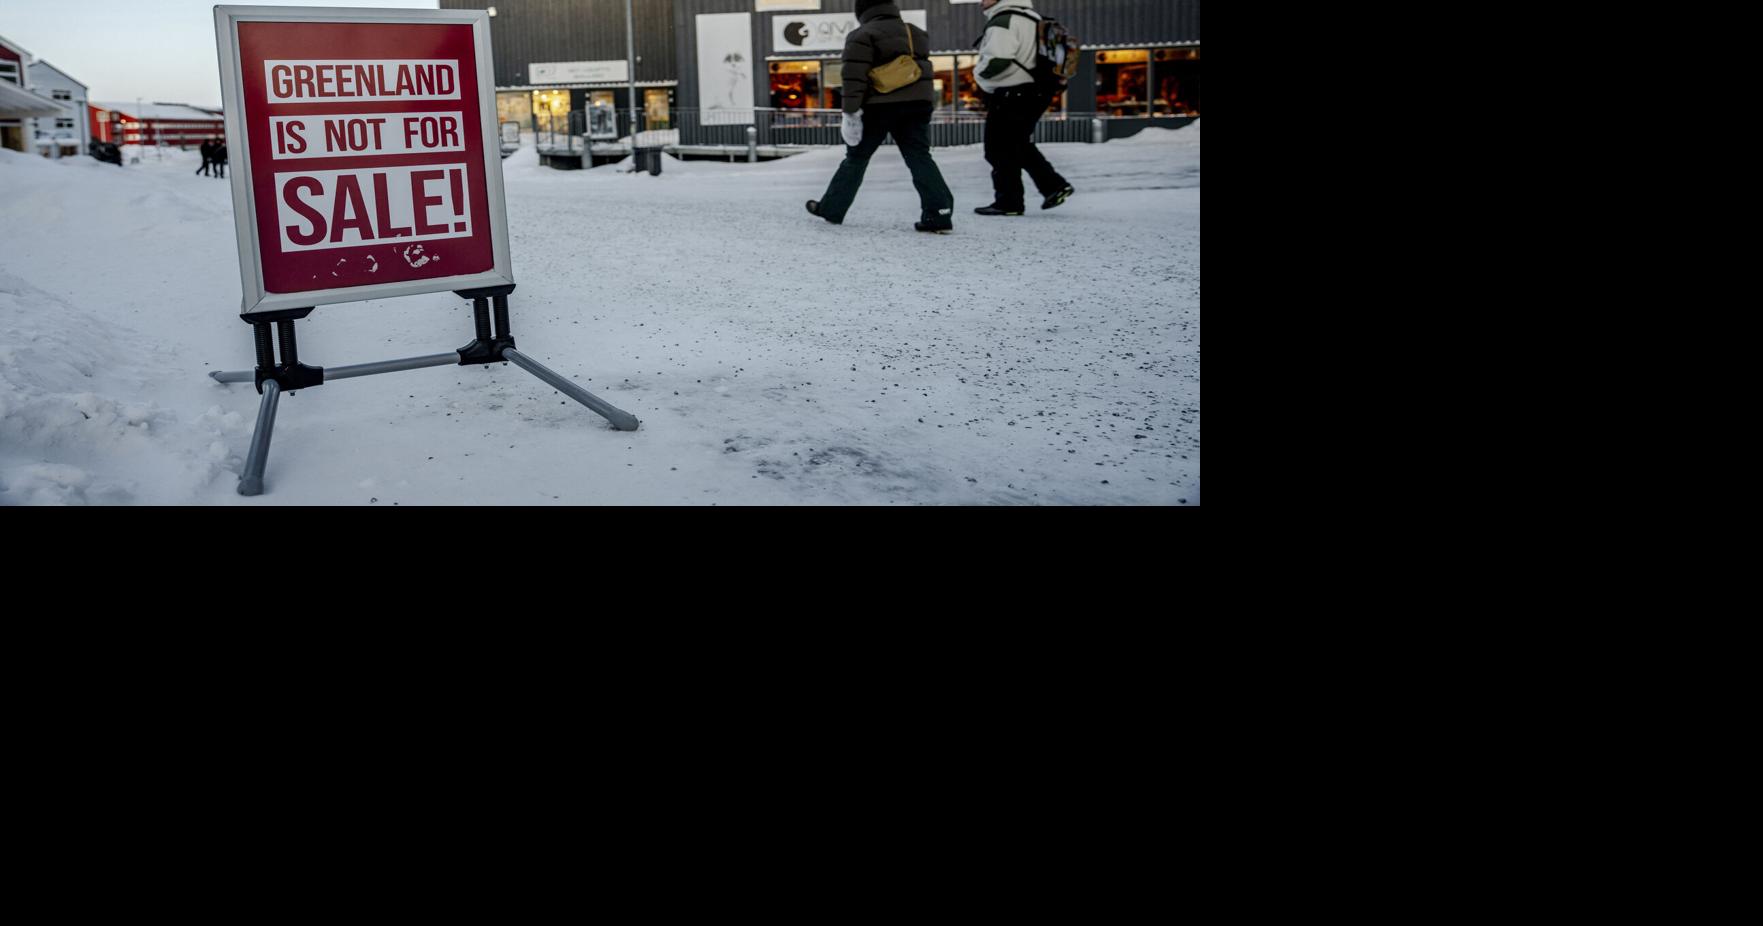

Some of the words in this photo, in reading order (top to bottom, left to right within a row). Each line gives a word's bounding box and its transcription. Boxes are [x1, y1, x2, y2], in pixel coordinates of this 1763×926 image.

[271, 64, 455, 98] GREENLAND
[275, 121, 307, 154] IS
[324, 118, 386, 152] NOT
[403, 116, 459, 149] FOR
[282, 168, 467, 246] SALE!
